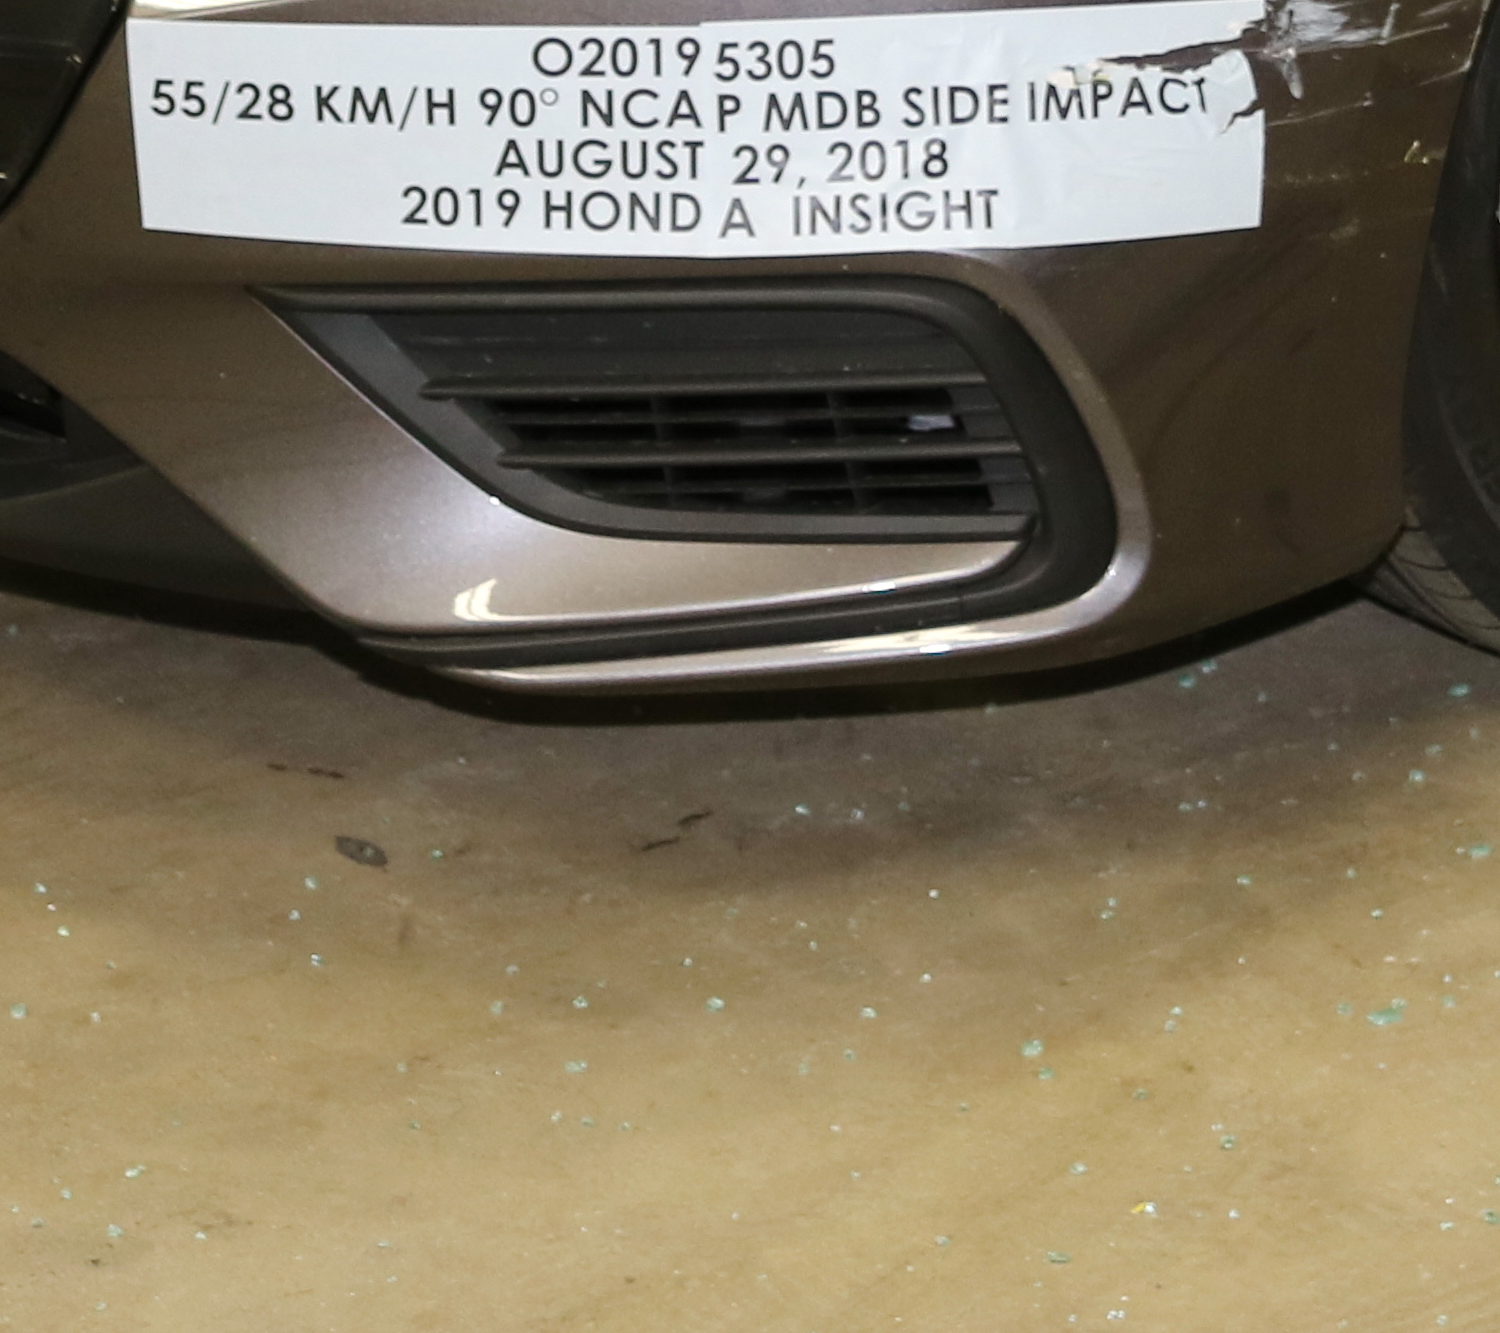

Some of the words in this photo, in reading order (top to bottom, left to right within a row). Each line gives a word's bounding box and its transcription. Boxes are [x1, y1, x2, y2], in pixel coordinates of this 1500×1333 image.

[151, 79, 295, 125] 55/28
[316, 85, 457, 132] KM/H
[479, 87, 560, 129] 90°
[581, 88, 743, 133] NCAP
[763, 89, 881, 133] MDB
[902, 83, 1009, 126] SIDE
[1028, 77, 1209, 122] IMPACT
[495, 139, 704, 180] AUGUST
[732, 145, 807, 189] 29,
[826, 138, 949, 182] 2018
[401, 187, 522, 230] 2019
[543, 190, 755, 238] HONDA
[792, 189, 999, 233] INSIGHT
